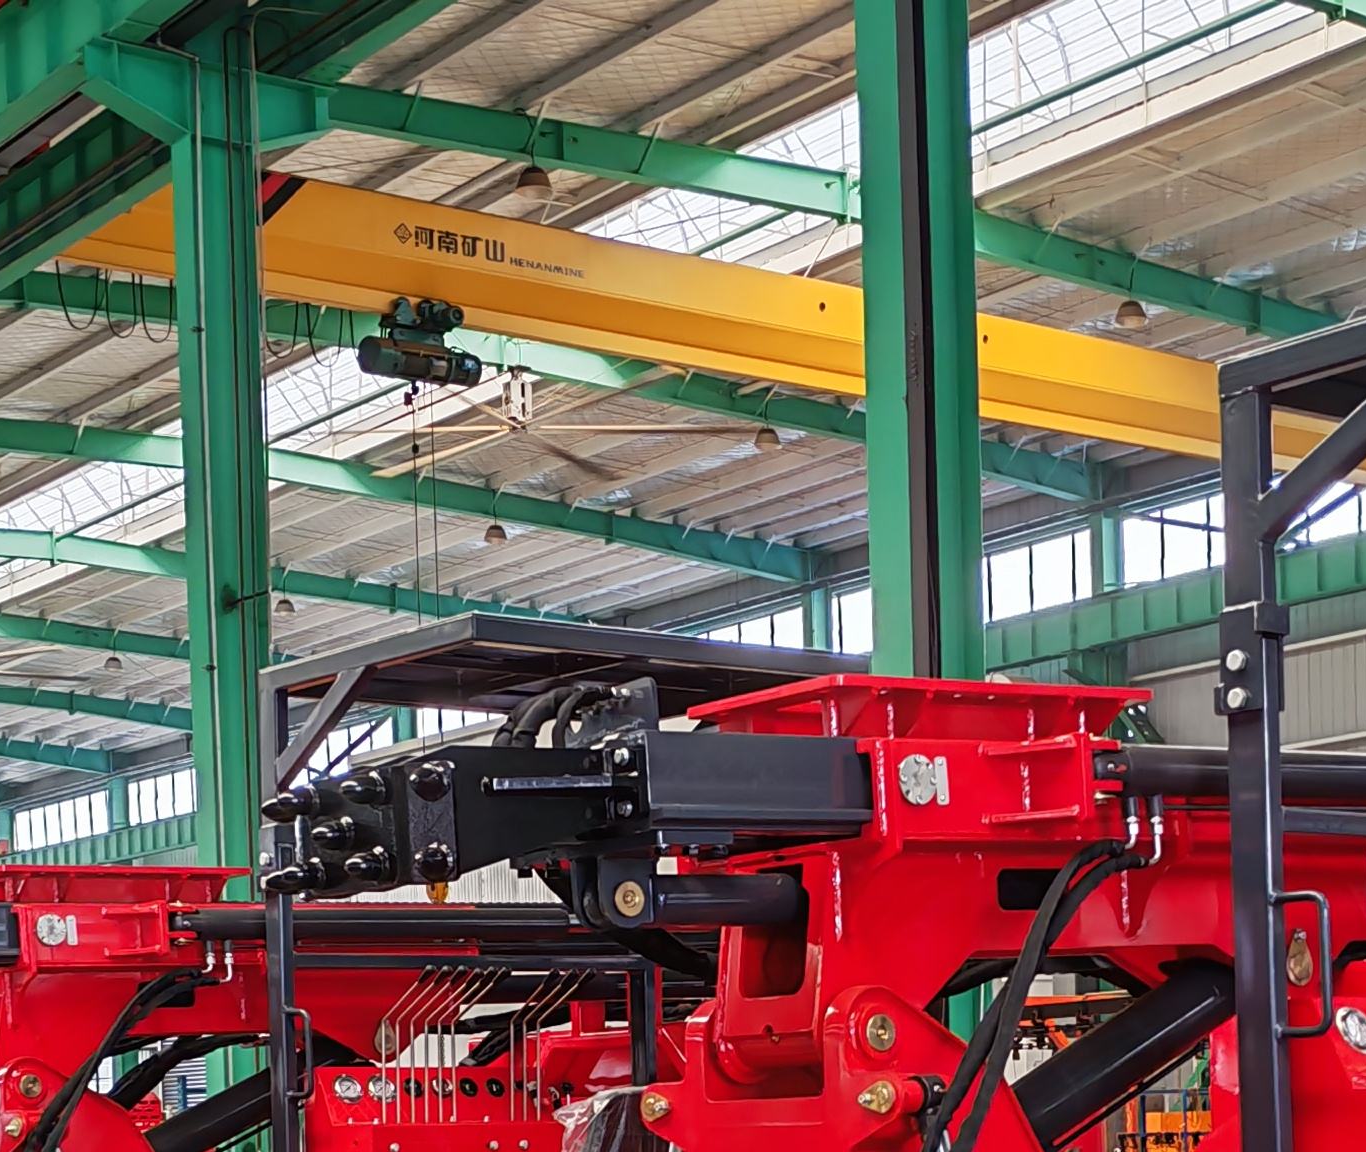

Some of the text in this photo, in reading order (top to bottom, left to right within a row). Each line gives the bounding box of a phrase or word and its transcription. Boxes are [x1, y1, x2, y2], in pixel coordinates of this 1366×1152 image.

[414, 225, 585, 278] 河南矿山 HENANMINE
